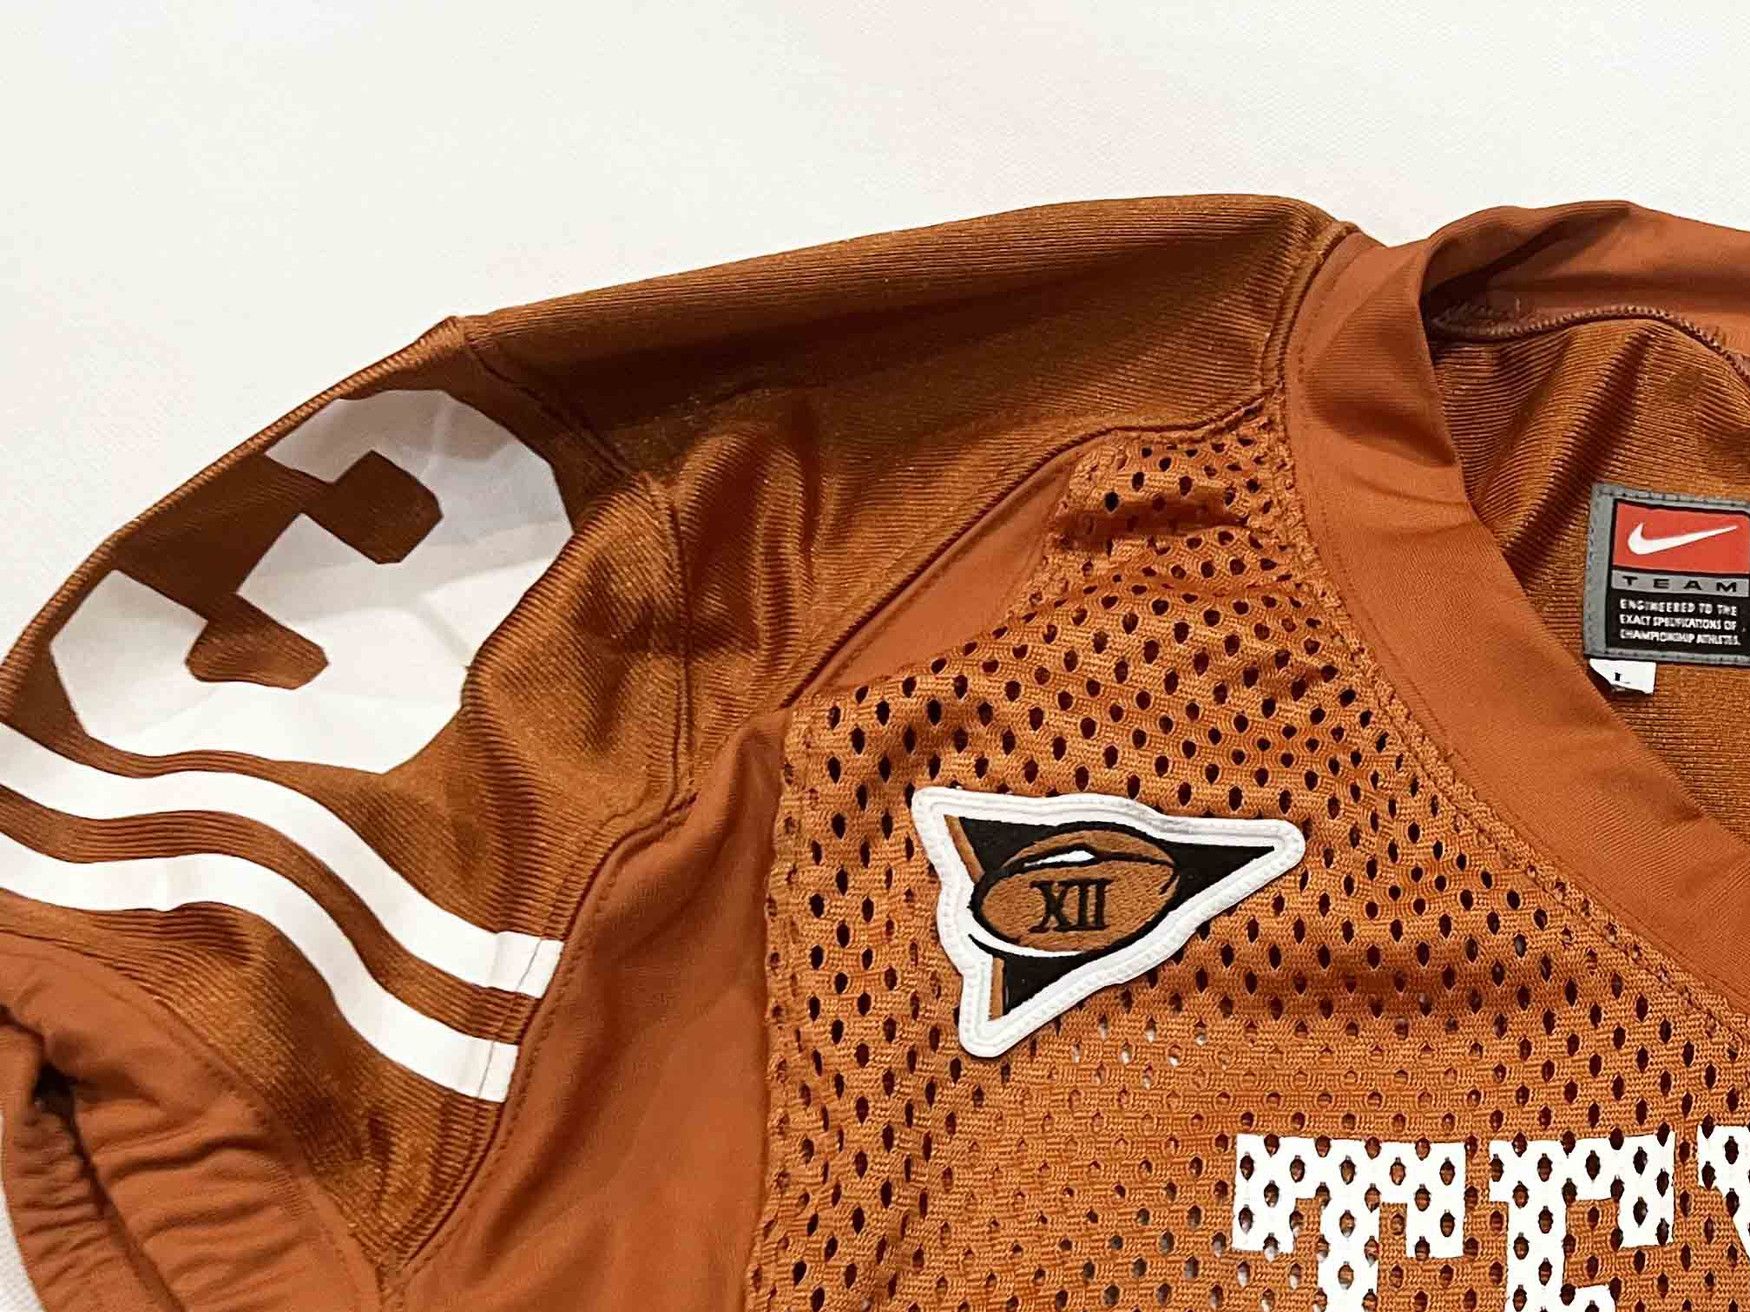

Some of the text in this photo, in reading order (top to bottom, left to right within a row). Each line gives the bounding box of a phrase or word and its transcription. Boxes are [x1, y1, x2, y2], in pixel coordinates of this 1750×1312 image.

[1622, 575, 1738, 593] TEAM
[1620, 598, 1738, 617] ENGINEERED TO THE
[1619, 614, 1737, 631] EXACT SPECIFICATIONS OF
[1620, 629, 1695, 644] CHAMPIONSHIP
[1029, 877, 1113, 935] XII
